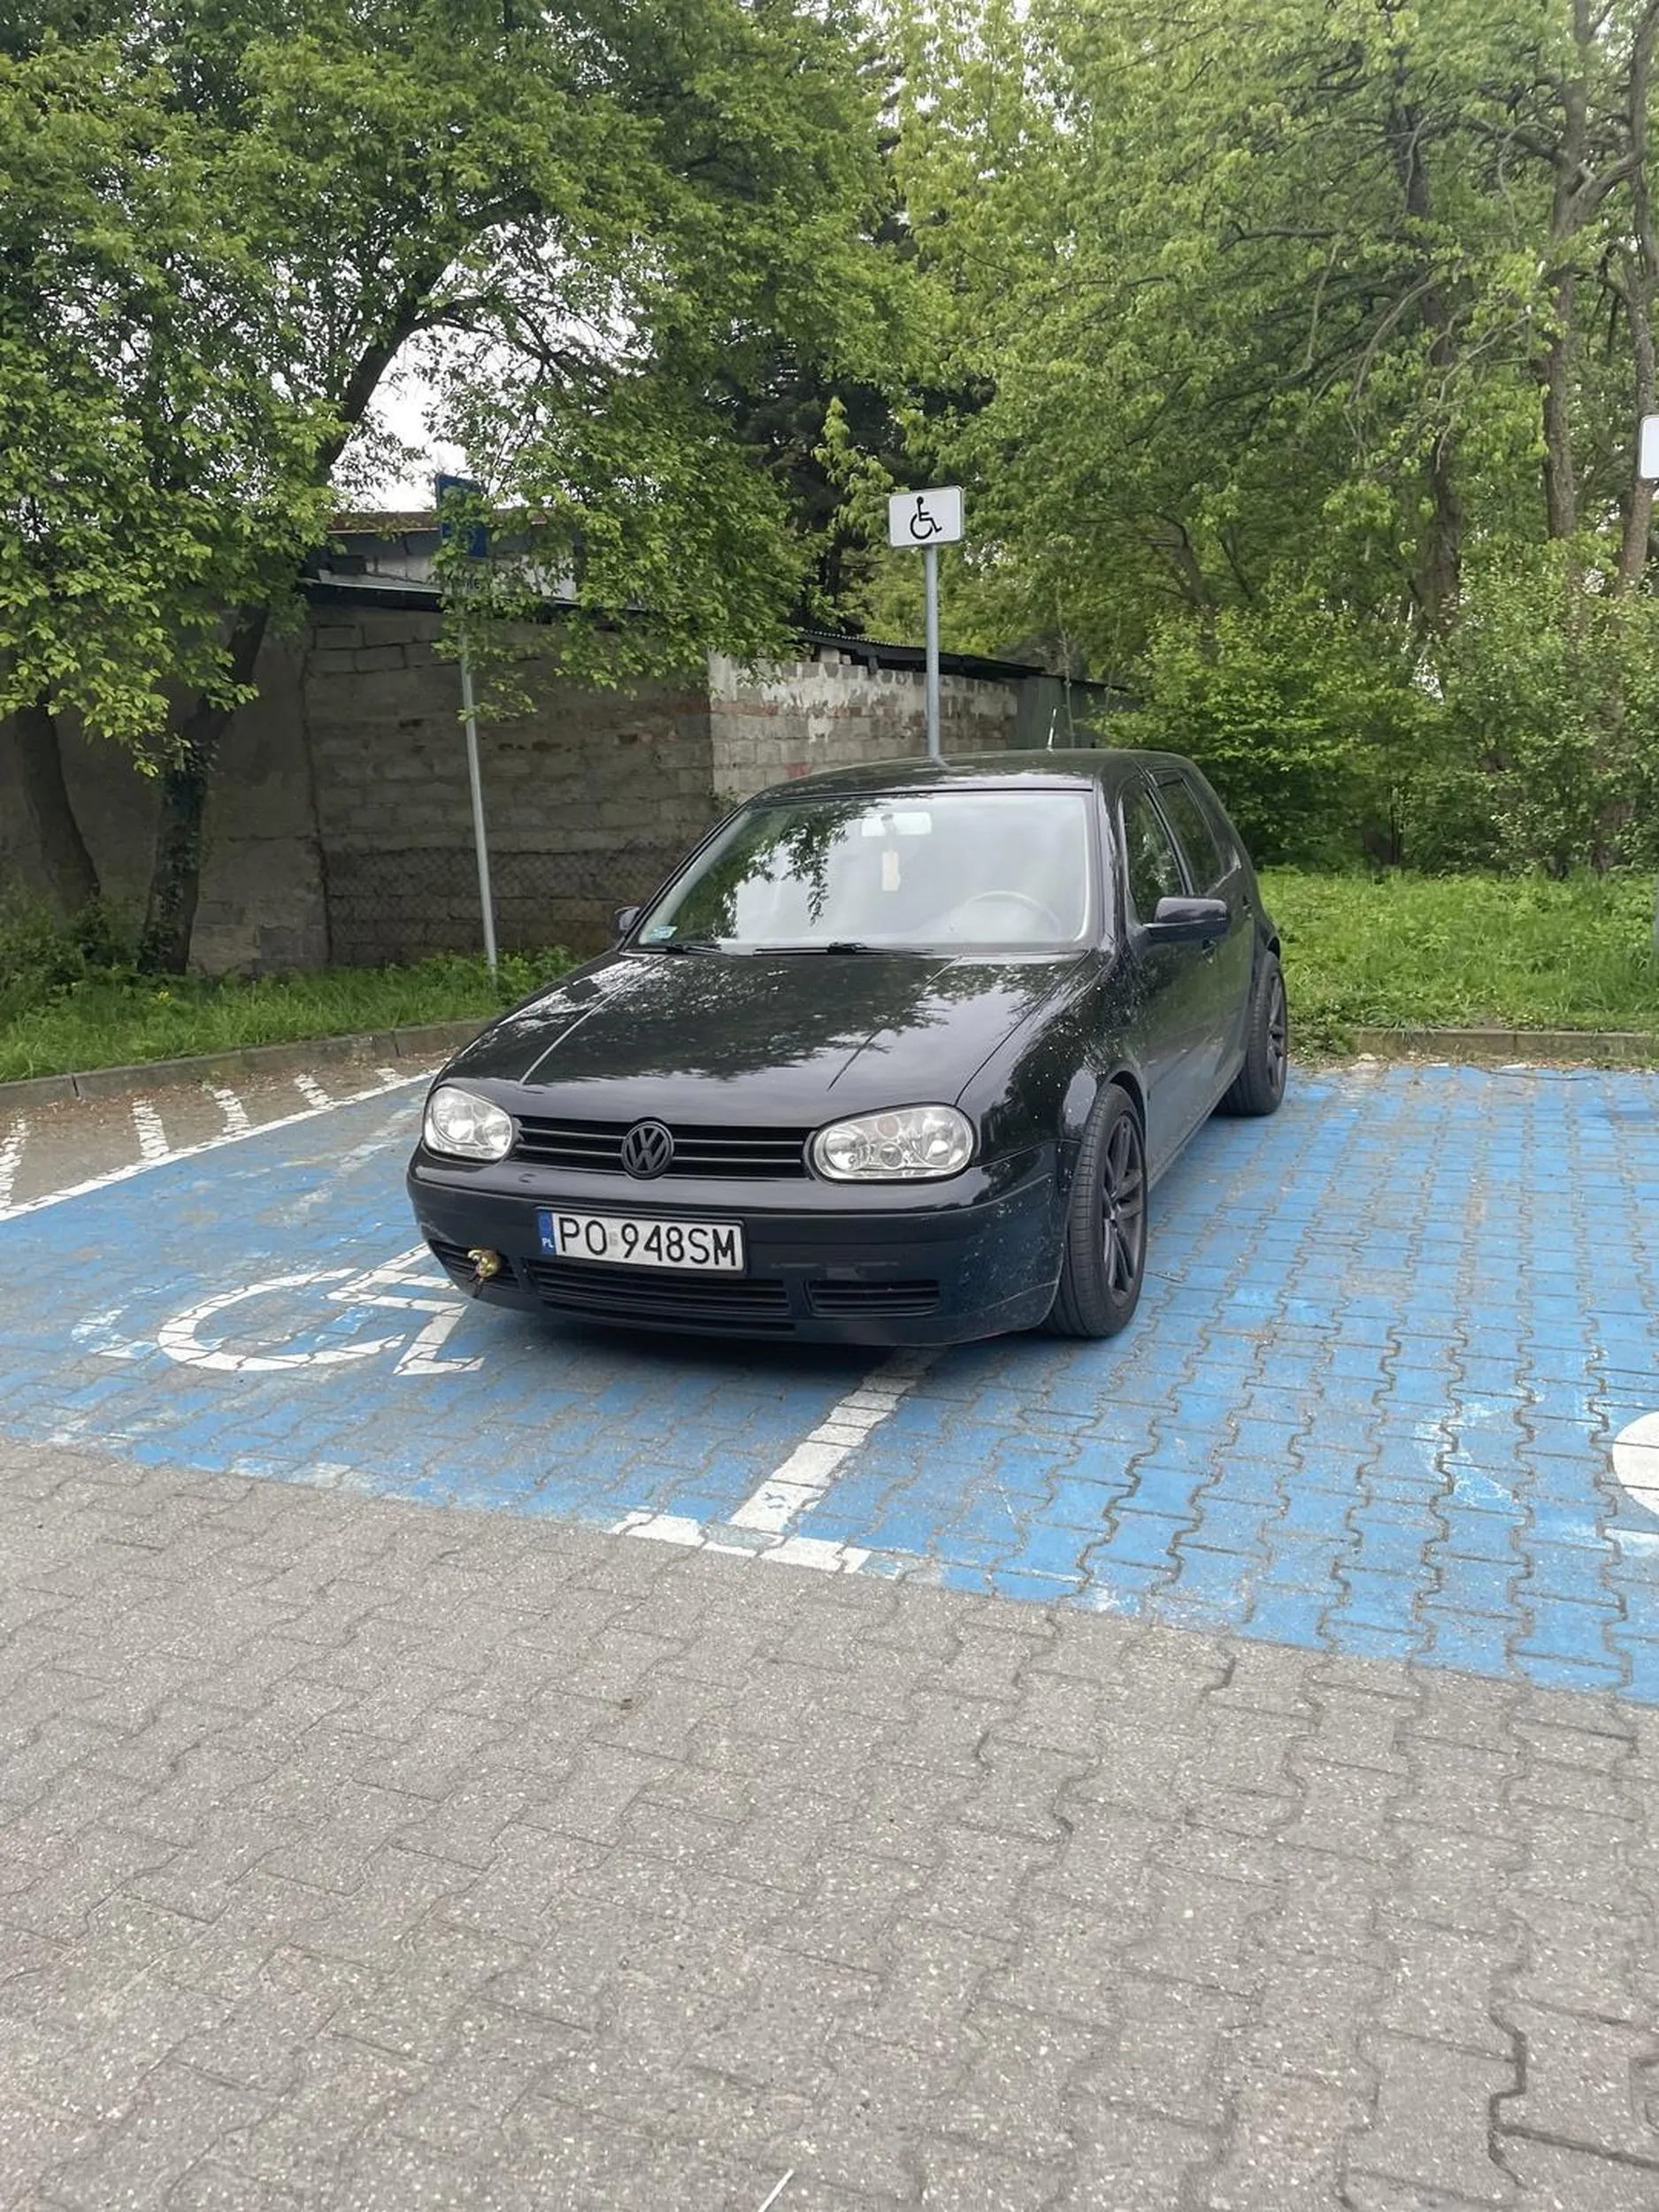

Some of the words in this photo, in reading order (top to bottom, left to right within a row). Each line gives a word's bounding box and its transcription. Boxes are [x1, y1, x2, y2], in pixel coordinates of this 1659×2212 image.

[541, 1237, 554, 1248] PL
[558, 1217, 608, 1256] PO
[621, 1222, 737, 1266] 948SM
